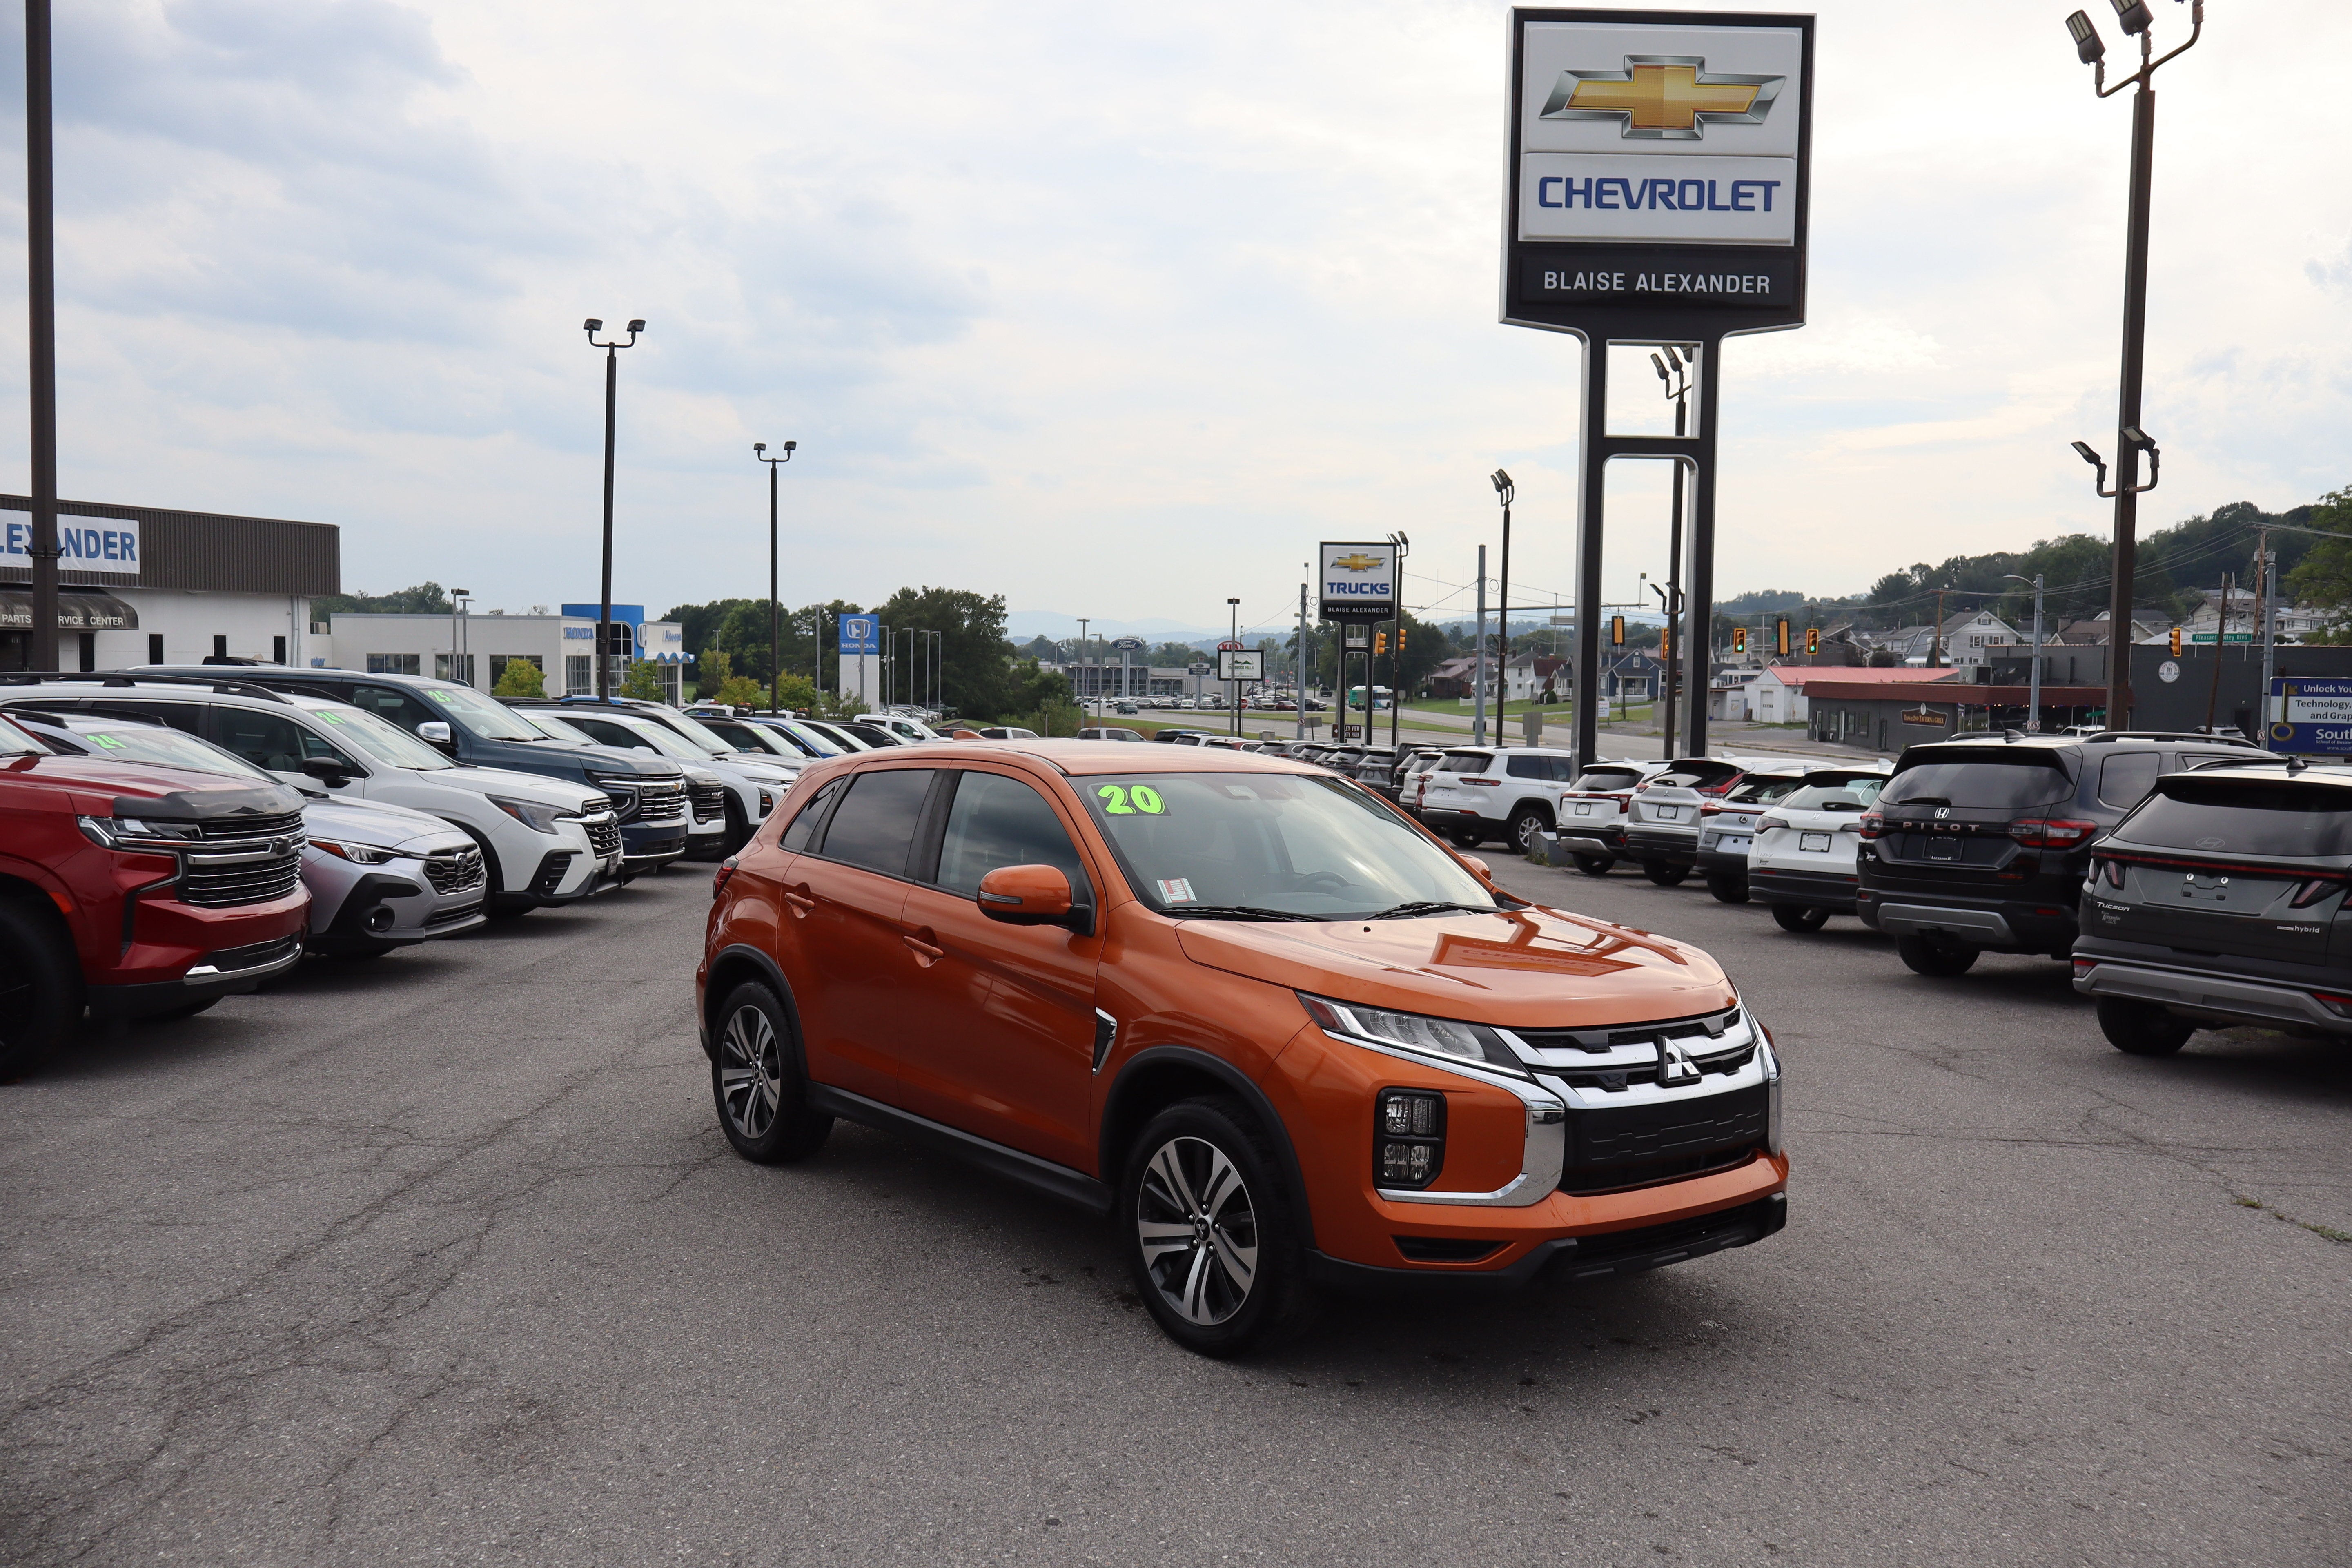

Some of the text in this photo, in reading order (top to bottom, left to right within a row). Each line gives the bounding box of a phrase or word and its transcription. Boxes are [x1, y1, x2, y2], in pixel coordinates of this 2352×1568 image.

[1539, 176, 1781, 212] CHEVROLET
[1544, 271, 1771, 294] BLAISE ALEXANDER
[0, 523, 136, 561] ENDER
[1327, 582, 1390, 595] TRUCKS
[2, 614, 124, 626] PARTS RVICE CENTER
[566, 627, 594, 639] HONDA
[1117, 640, 1136, 648] Ford
[2303, 684, 2336, 693] Unlock
[428, 690, 452, 702] 25
[2296, 699, 2351, 710] Technology,
[315, 711, 346, 725] 24
[86, 735, 127, 749] 24
[1098, 785, 1165, 815] 20
[1903, 822, 1979, 831] PILOT
[2294, 925, 2320, 934] hybrid
